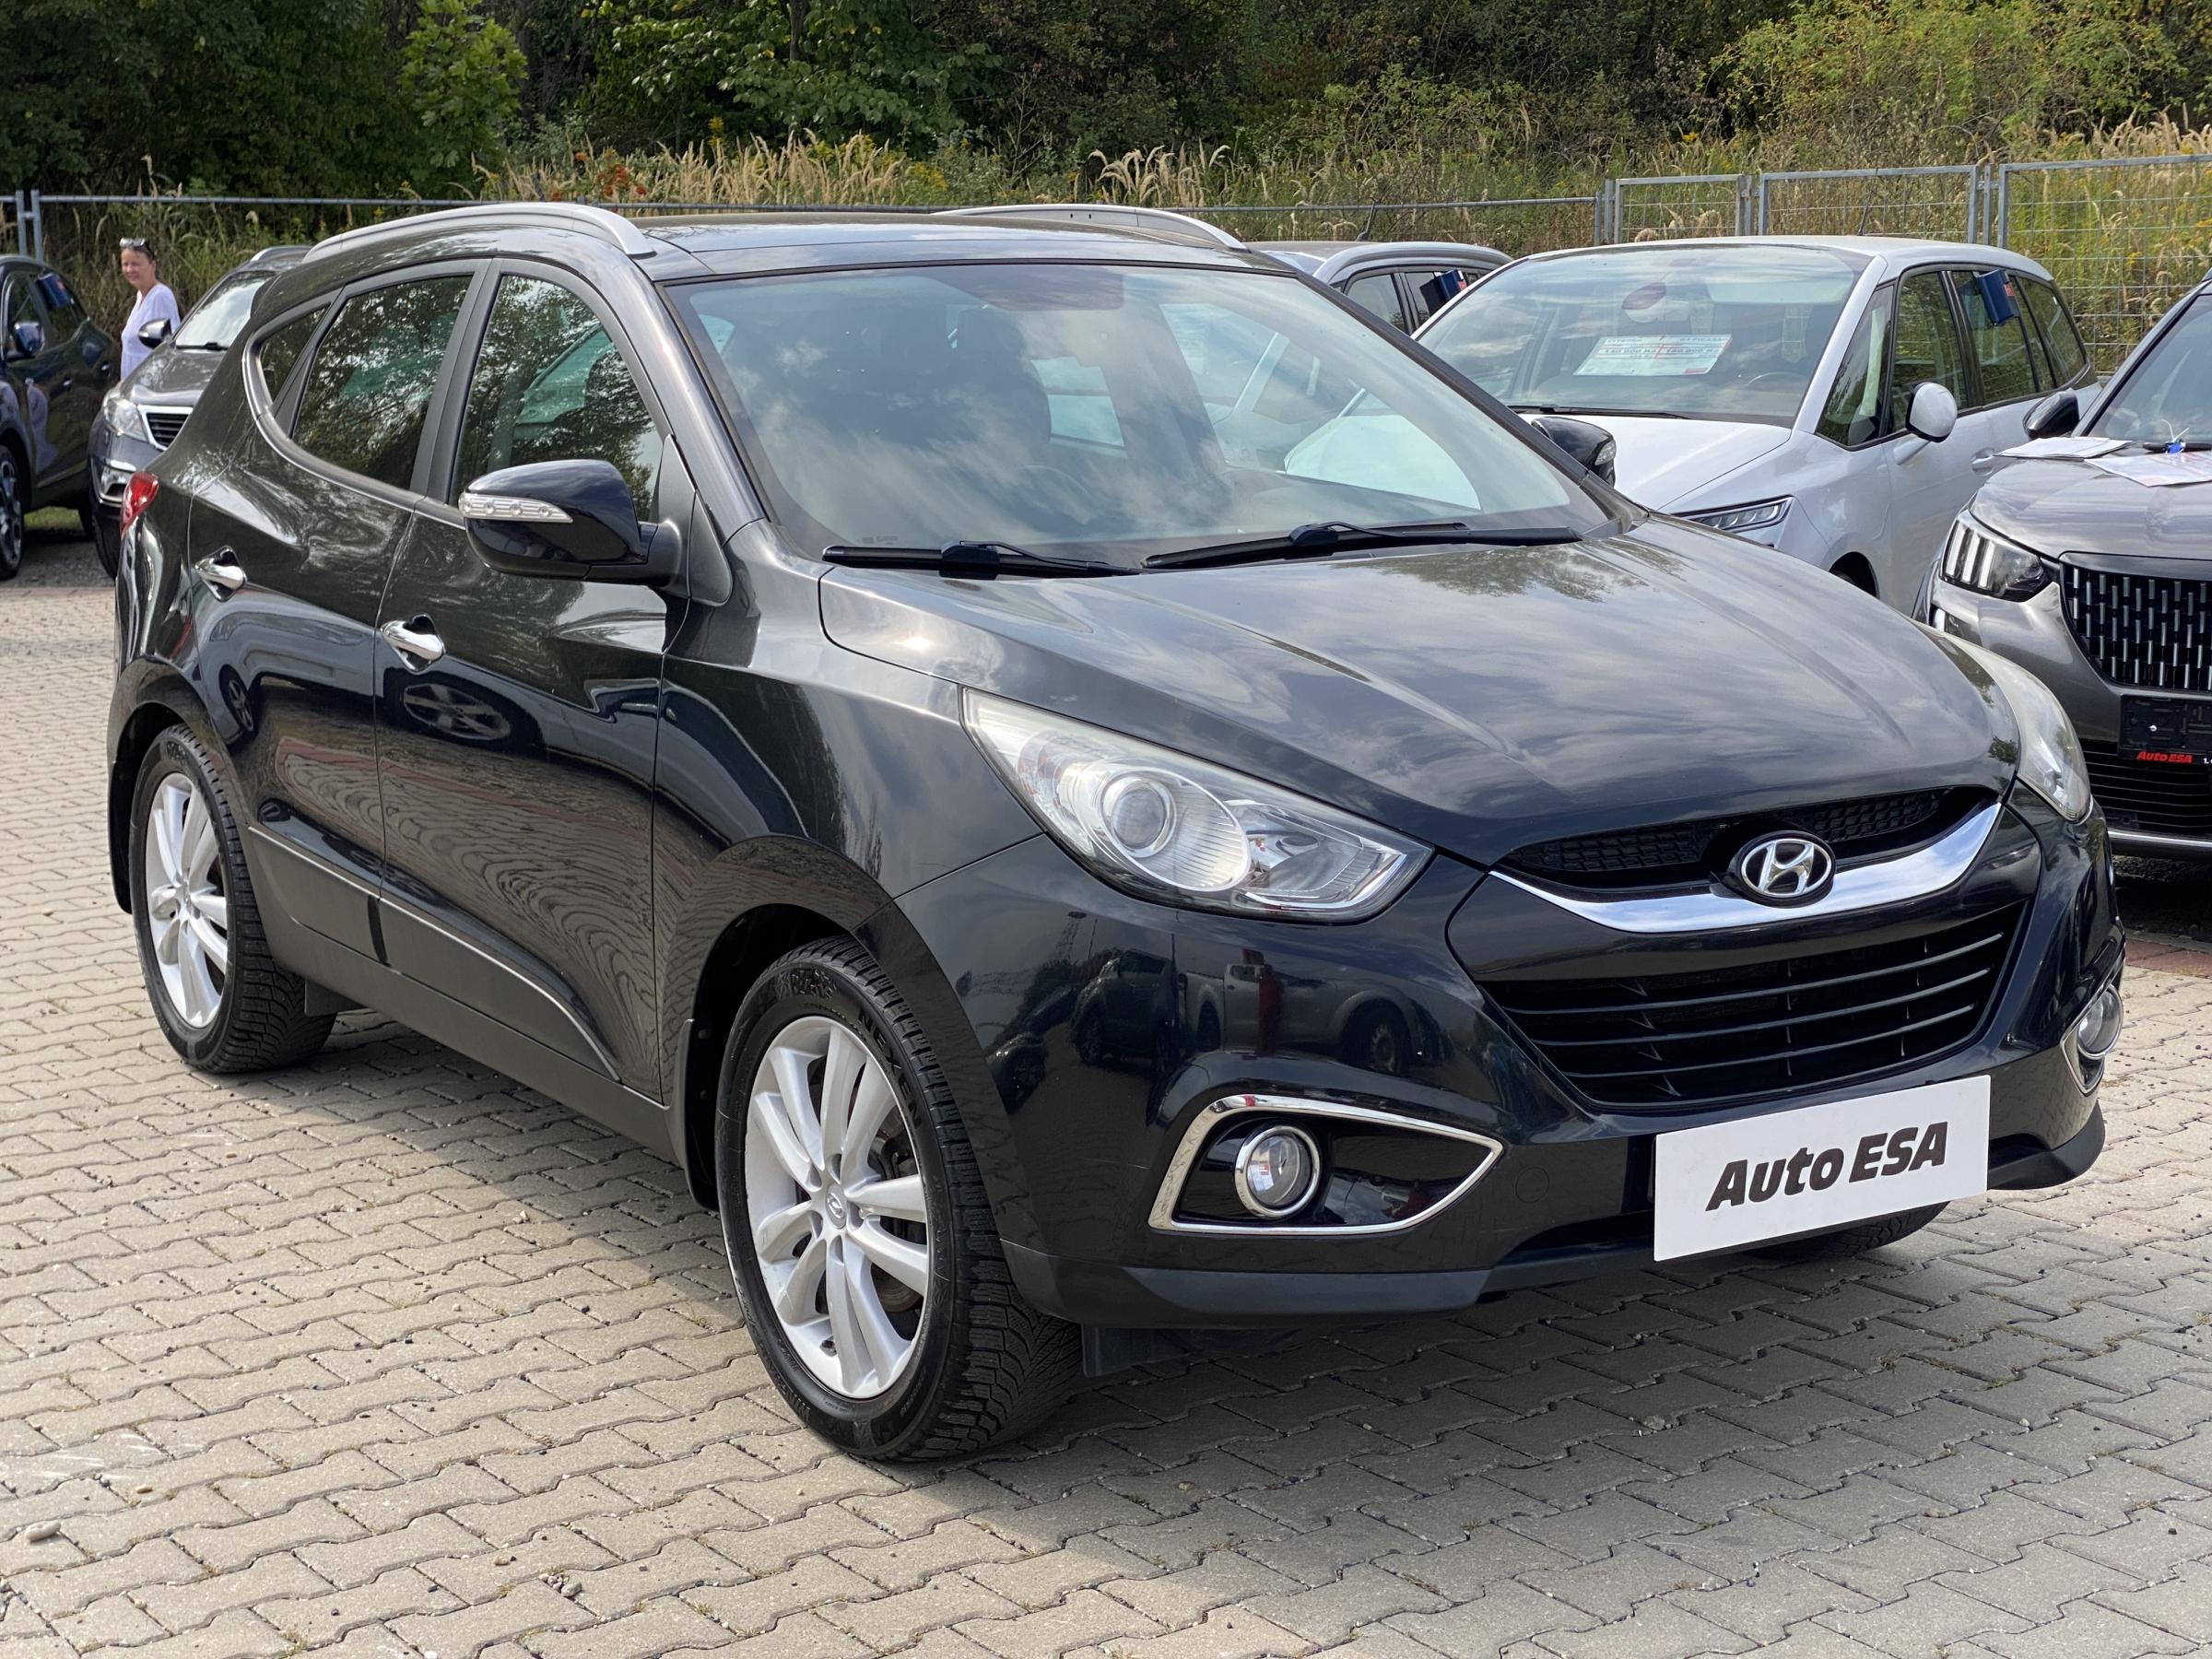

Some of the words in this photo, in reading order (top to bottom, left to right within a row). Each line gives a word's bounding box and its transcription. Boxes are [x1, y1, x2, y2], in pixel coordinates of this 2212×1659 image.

[2136, 751, 2168, 761] Auto
[2168, 753, 2193, 764] ESA
[858, 1007, 922, 1129] NEXEN
[1705, 1147, 1844, 1212] Auto
[1849, 1121, 1948, 1183] ESA
